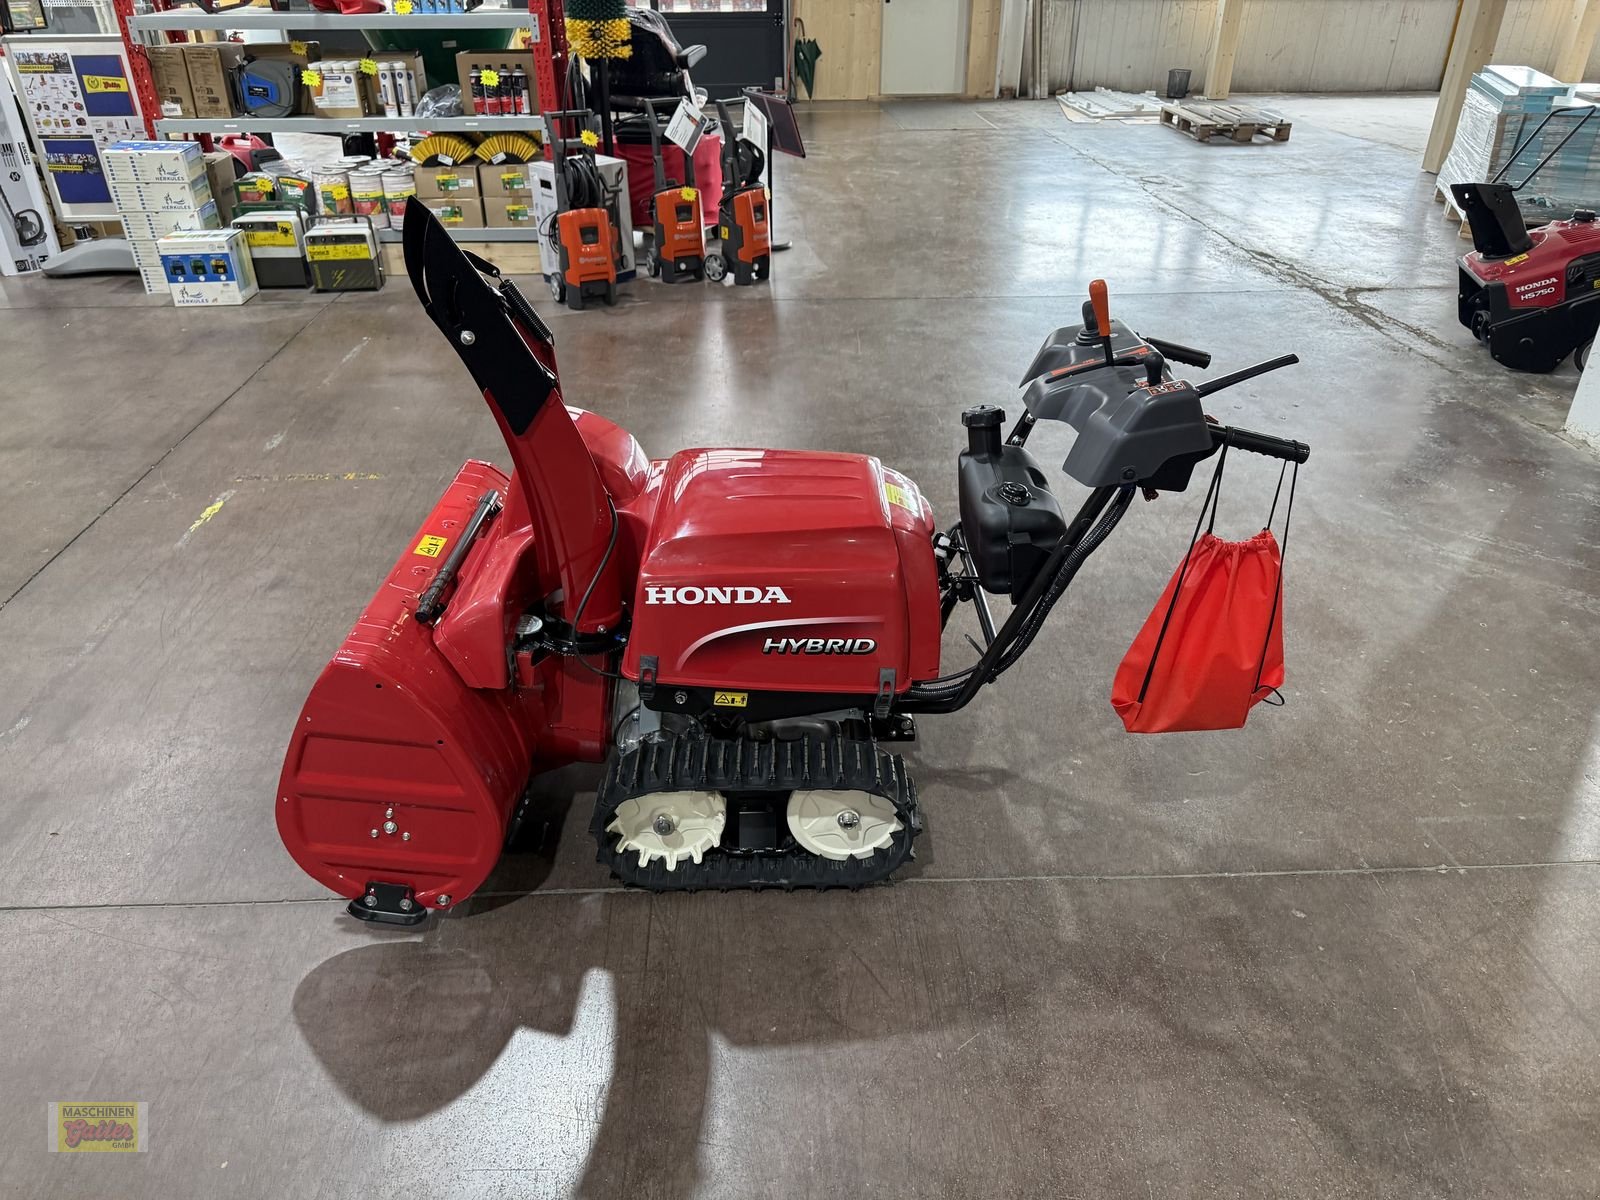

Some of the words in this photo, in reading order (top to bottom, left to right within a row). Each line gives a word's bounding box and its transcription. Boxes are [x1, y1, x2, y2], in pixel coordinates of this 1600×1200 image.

[1515, 277, 1559, 293] HONDA
[1520, 286, 1555, 301] HS750
[645, 587, 792, 605] HONDA
[762, 637, 877, 655] HYBRID
